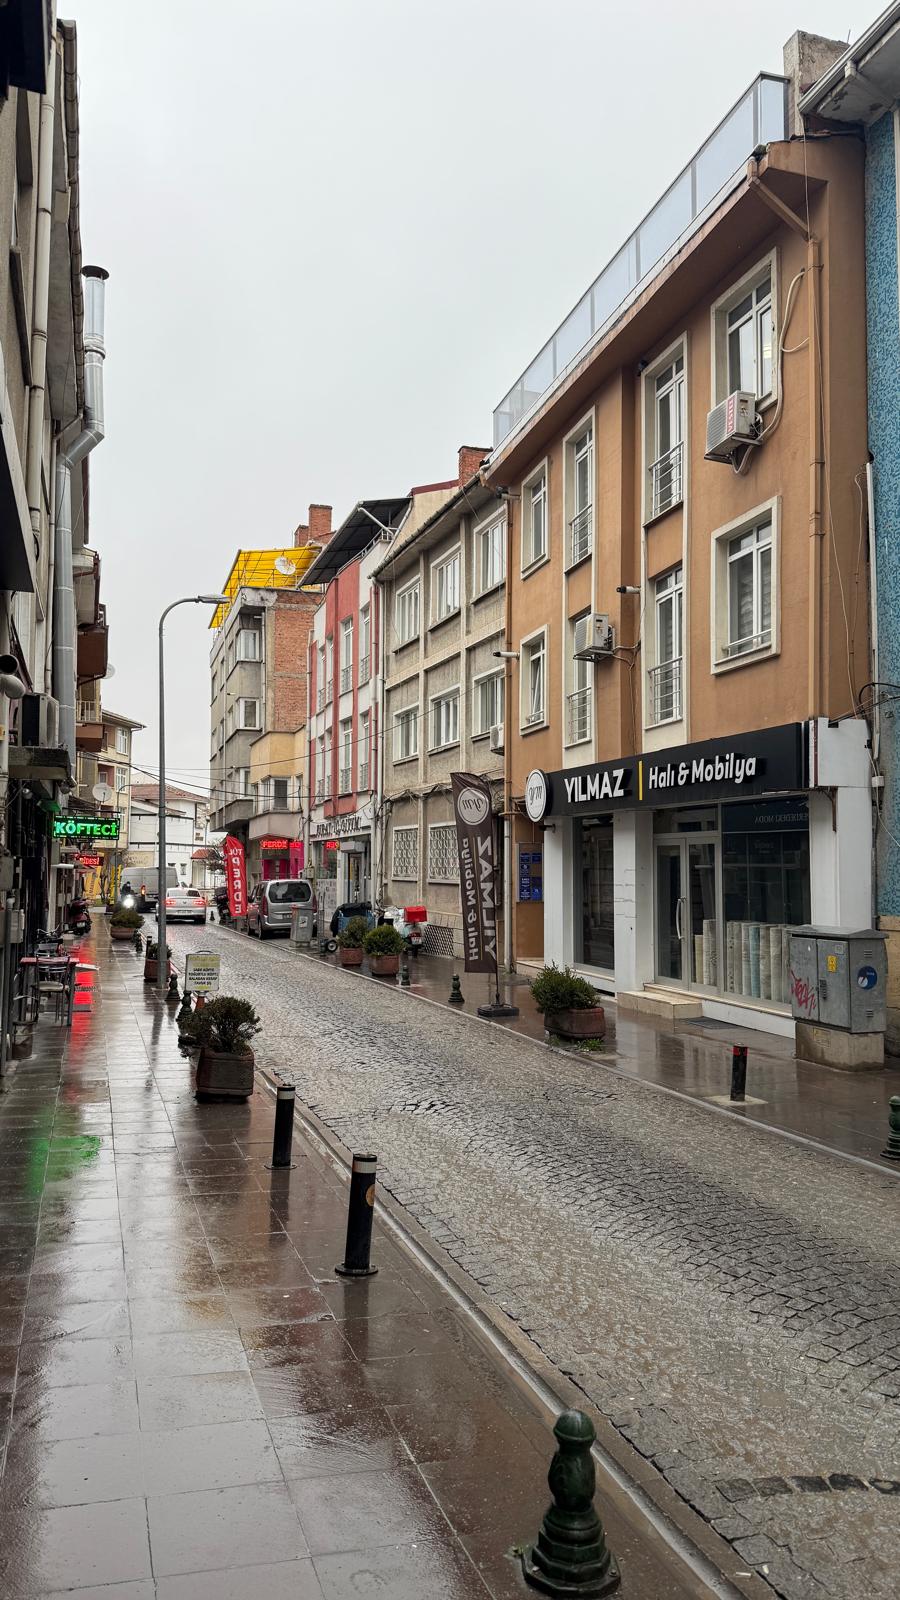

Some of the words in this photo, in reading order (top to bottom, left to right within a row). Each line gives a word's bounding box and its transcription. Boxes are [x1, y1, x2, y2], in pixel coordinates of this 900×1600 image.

[564, 768, 625, 804] YILMAZ
[649, 766, 675, 790] Halı
[677, 763, 691, 786] &
[691, 753, 757, 785] Mobilya
[55, 820, 117, 836] KÖFTECİ
[263, 840, 287, 848] PERDE
